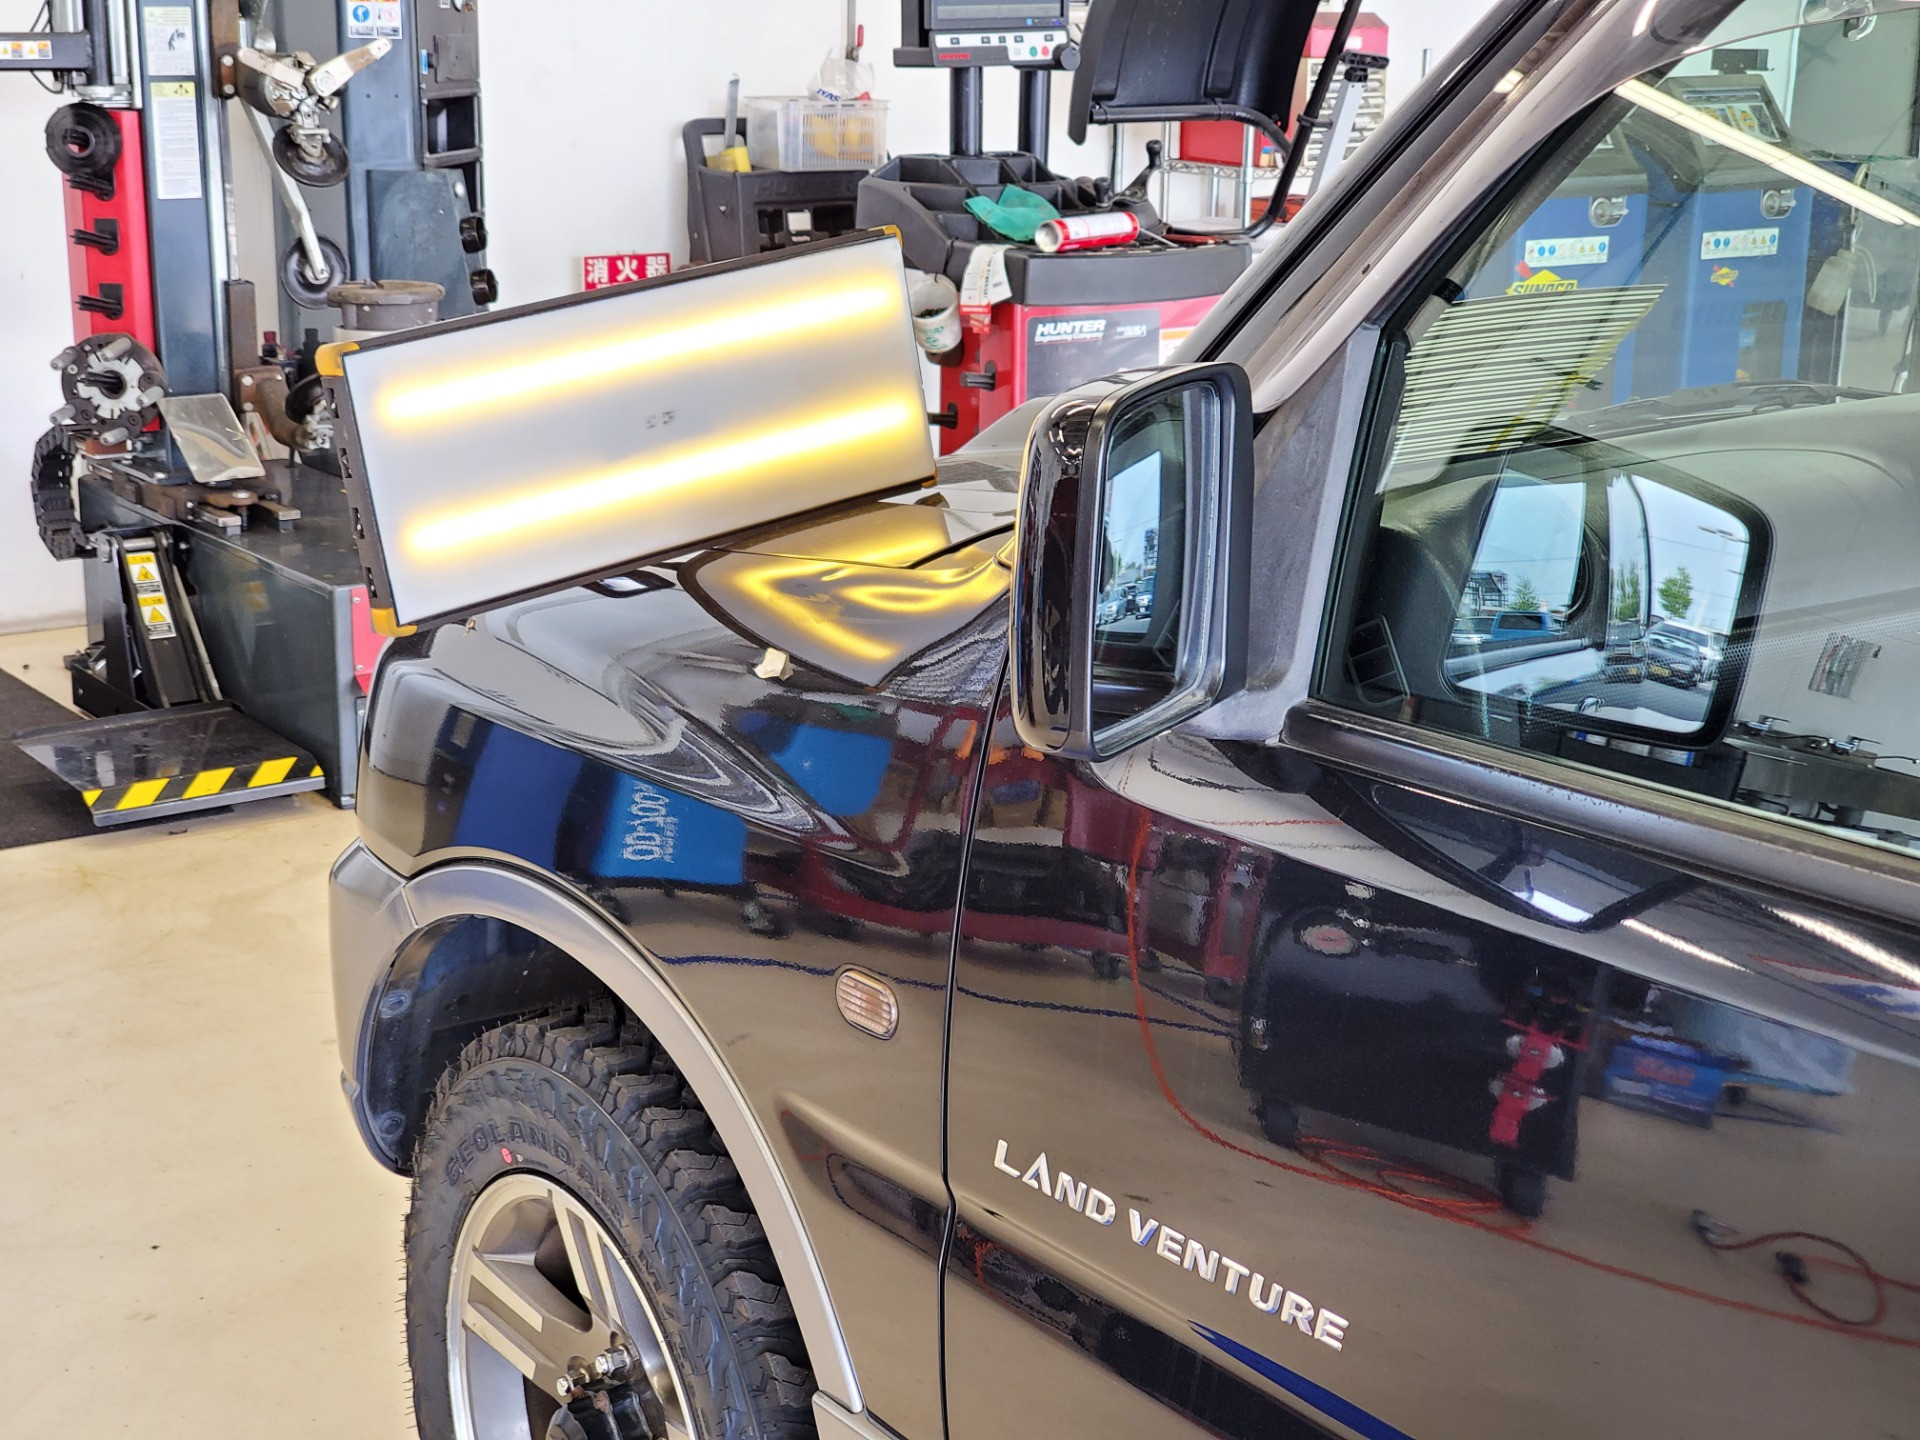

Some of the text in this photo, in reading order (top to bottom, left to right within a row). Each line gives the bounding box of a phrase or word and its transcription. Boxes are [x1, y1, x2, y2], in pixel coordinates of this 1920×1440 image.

[586, 255, 668, 284] 消火器
[1035, 319, 1107, 336] HUNTER
[993, 1138, 1350, 1352] LAND VENTURE
